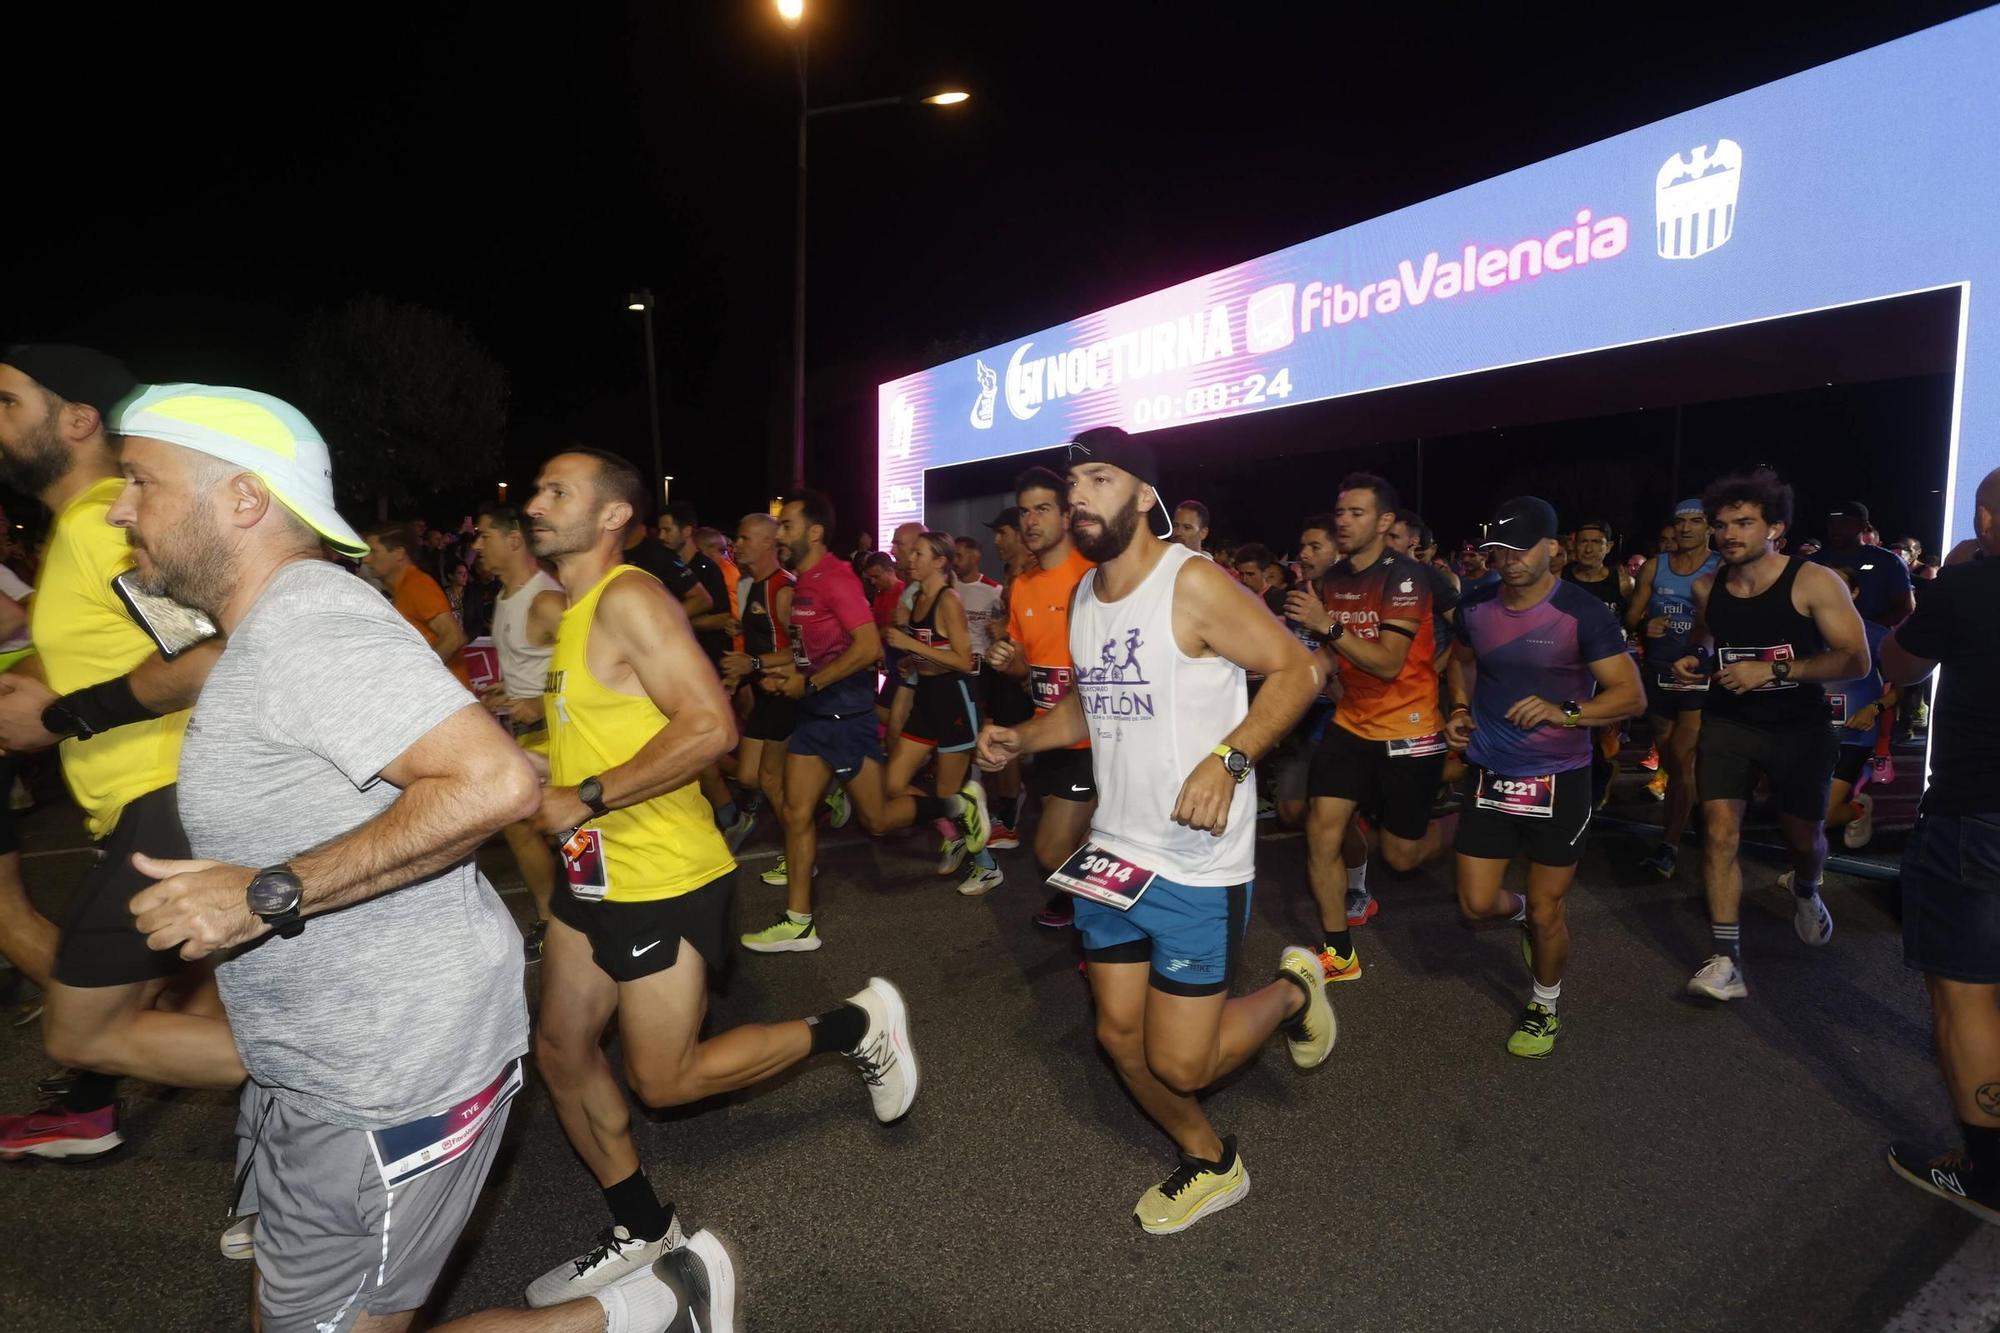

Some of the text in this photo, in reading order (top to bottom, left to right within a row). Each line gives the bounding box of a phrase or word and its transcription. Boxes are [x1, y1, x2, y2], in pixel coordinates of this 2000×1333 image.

[1047, 304, 1234, 401] NOCTURNA
[1133, 367, 1293, 425] 00:00:24
[1670, 620, 1692, 634] agu
[1037, 682, 1060, 696] 1161
[1080, 691, 1155, 717] RIATLÓN
[1492, 779, 1537, 797] 4221
[1079, 855, 1134, 883] 3014
[461, 1102, 480, 1119] TYE
